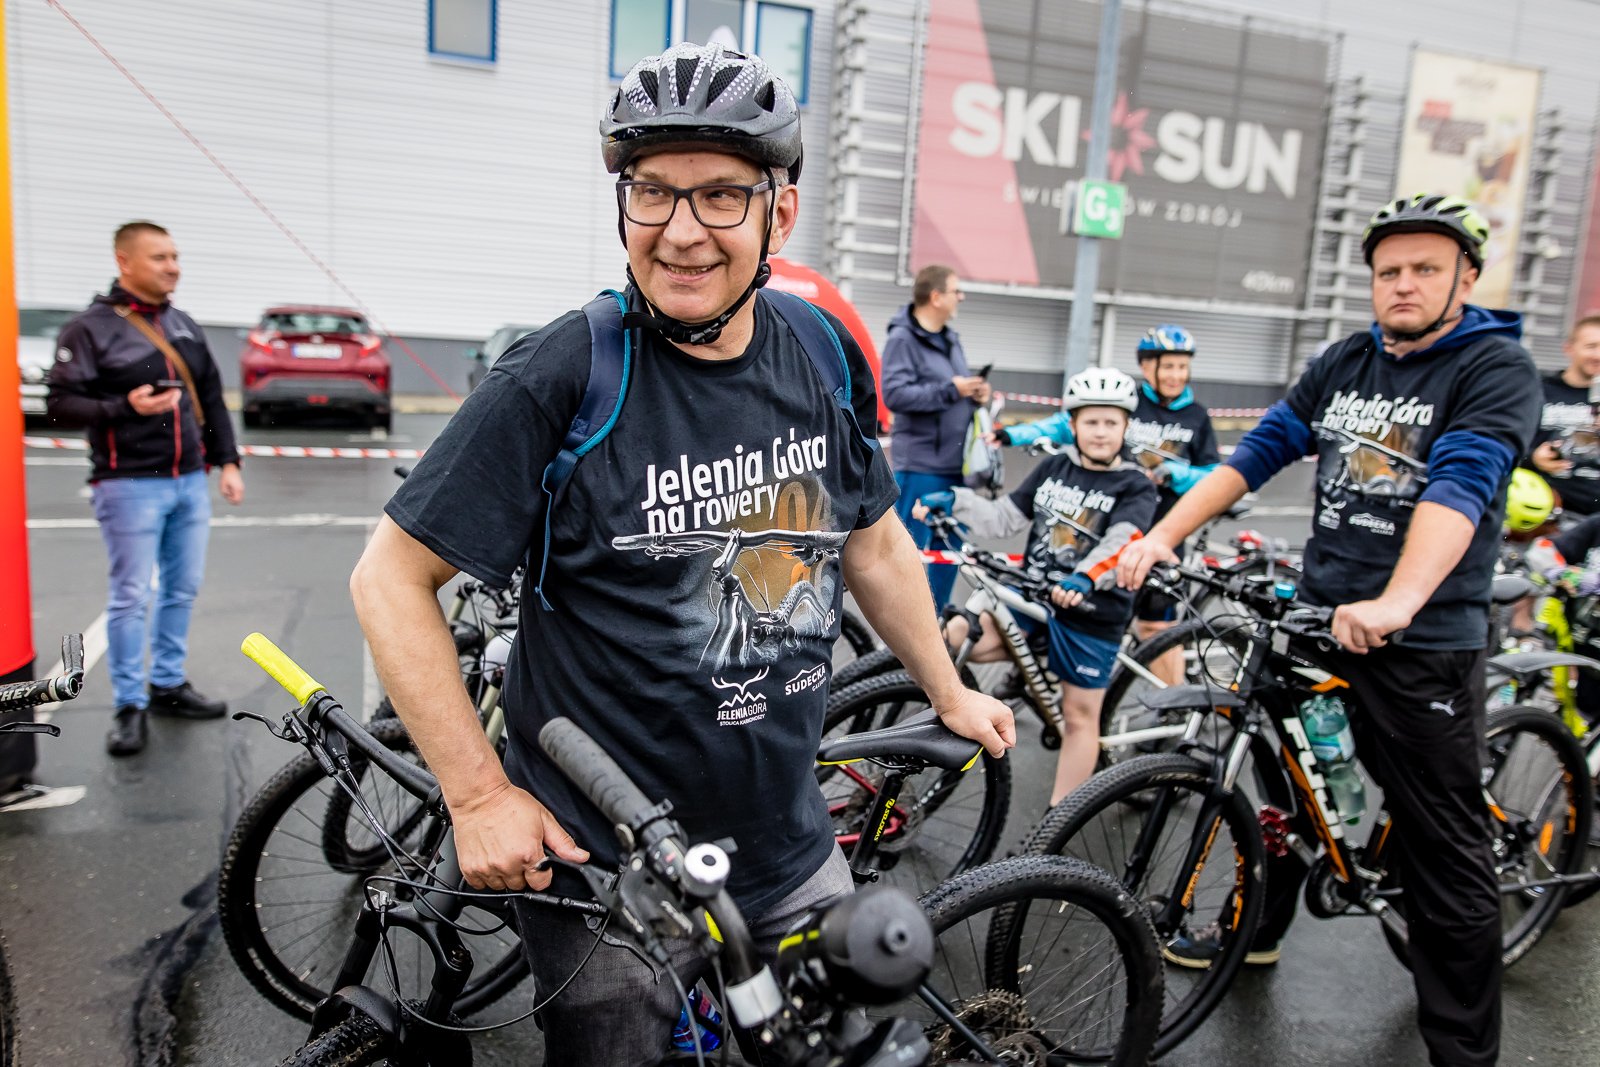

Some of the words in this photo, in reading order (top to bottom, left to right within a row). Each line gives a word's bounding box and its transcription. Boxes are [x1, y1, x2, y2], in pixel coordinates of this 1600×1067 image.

[949, 82, 1082, 168] SKI
[1153, 111, 1302, 199] SUN
[641, 444, 764, 510] Jelenia
[772, 427, 827, 480] Góra
[647, 504, 686, 535] na
[693, 482, 781, 530] rowery
[0, 685, 37, 702] HEY
[784, 664, 827, 697] SUDECKA
